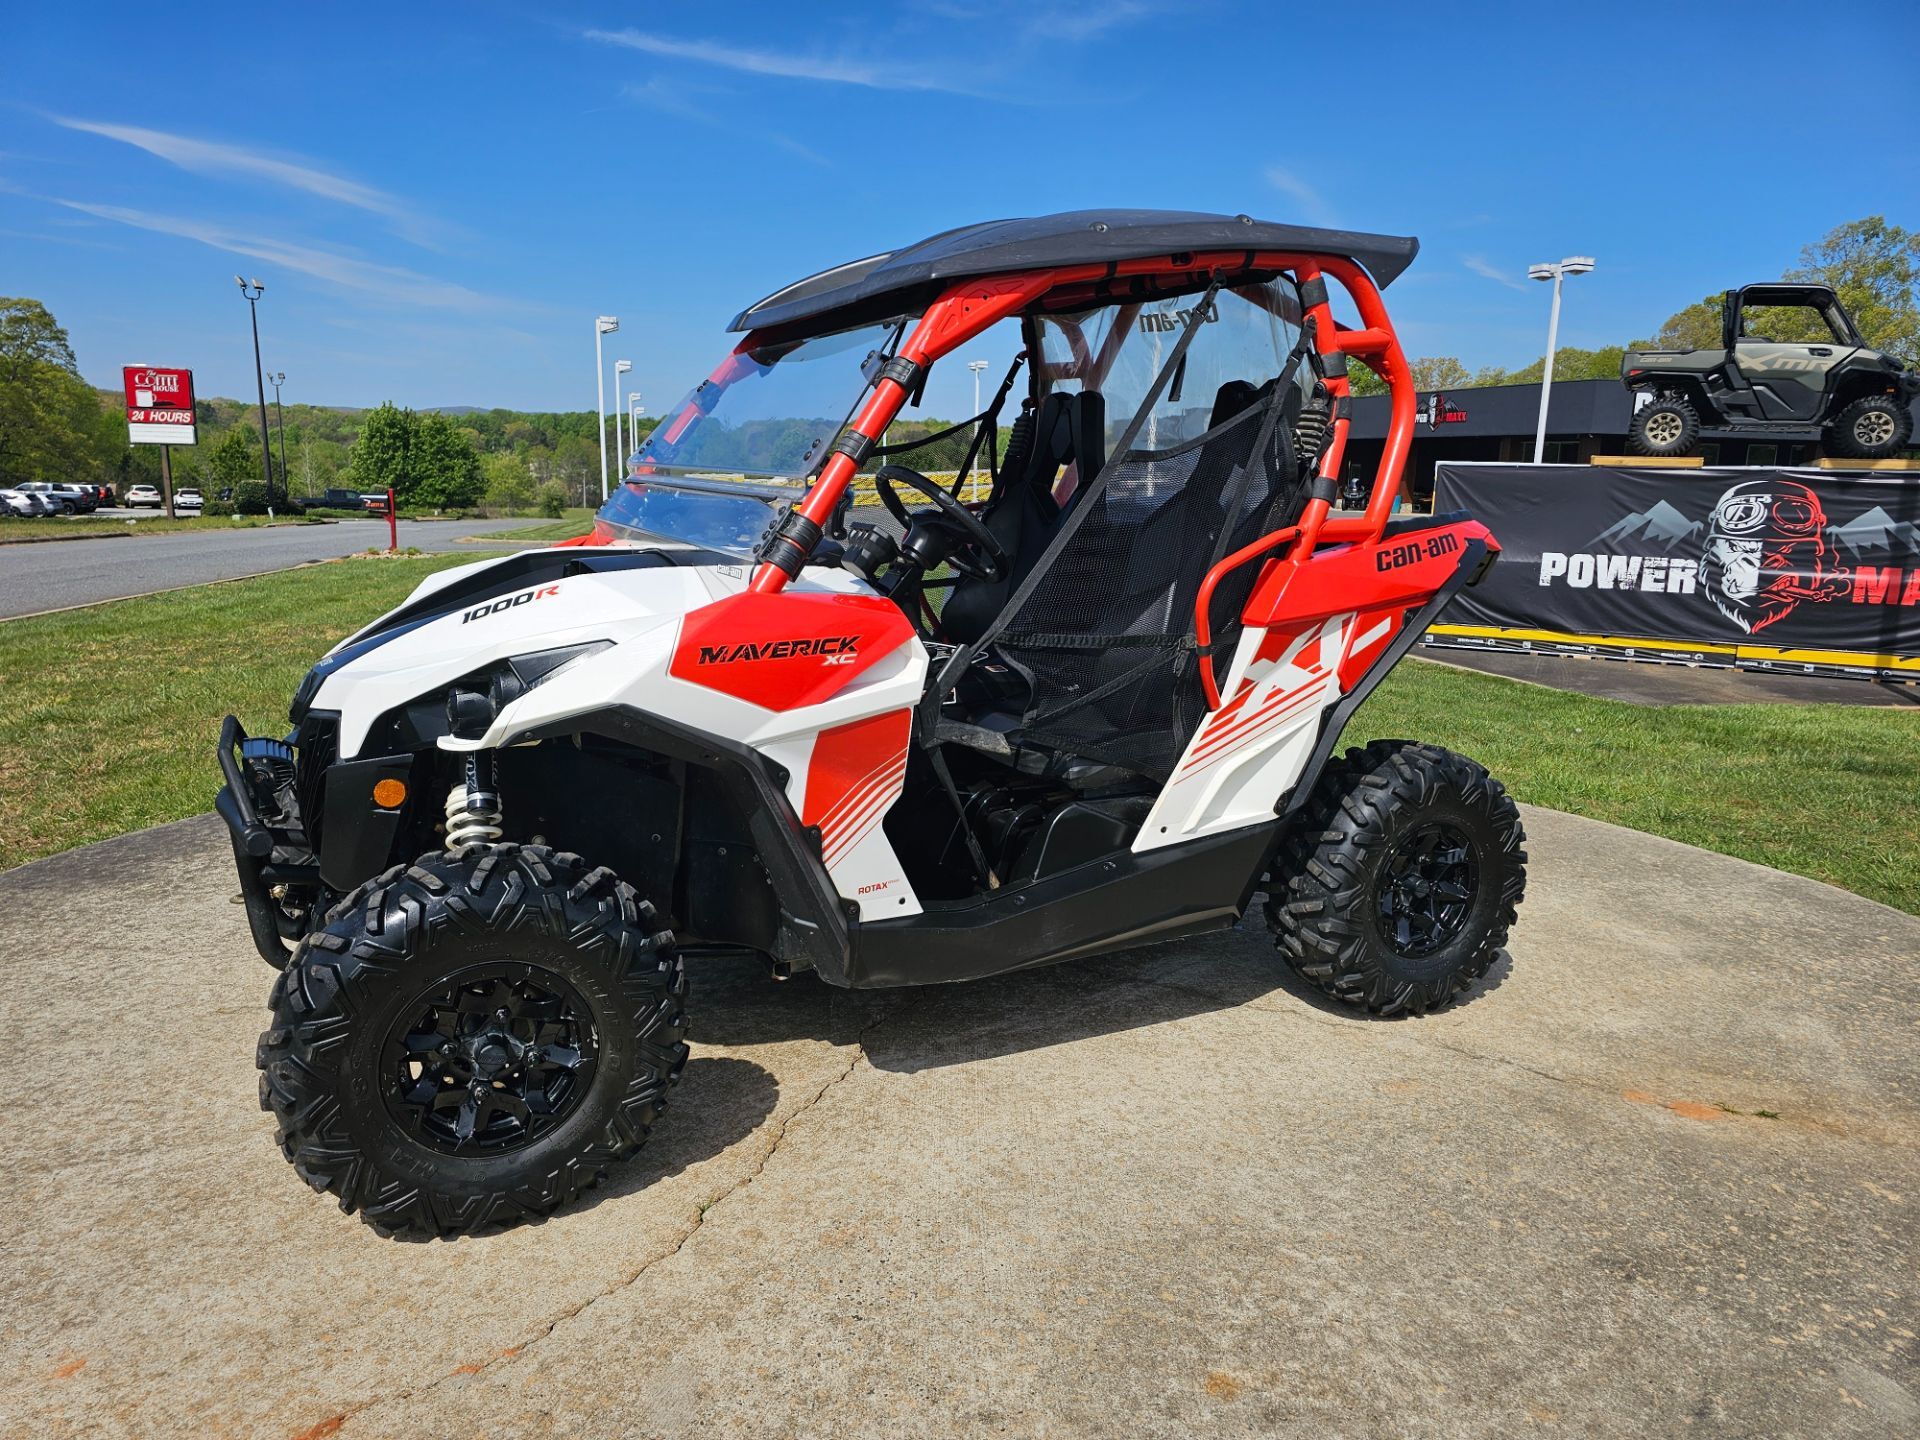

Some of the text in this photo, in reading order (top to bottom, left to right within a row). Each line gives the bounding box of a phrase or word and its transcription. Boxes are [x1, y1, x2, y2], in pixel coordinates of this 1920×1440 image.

[132, 411, 191, 423] 24 HOURS
[1376, 533, 1459, 572] can-am
[1539, 552, 1698, 594] POWER
[462, 586, 559, 625] 1000R
[699, 635, 862, 665] MAVERICK
[821, 653, 858, 666] XC
[858, 881, 888, 895] ROTAX
